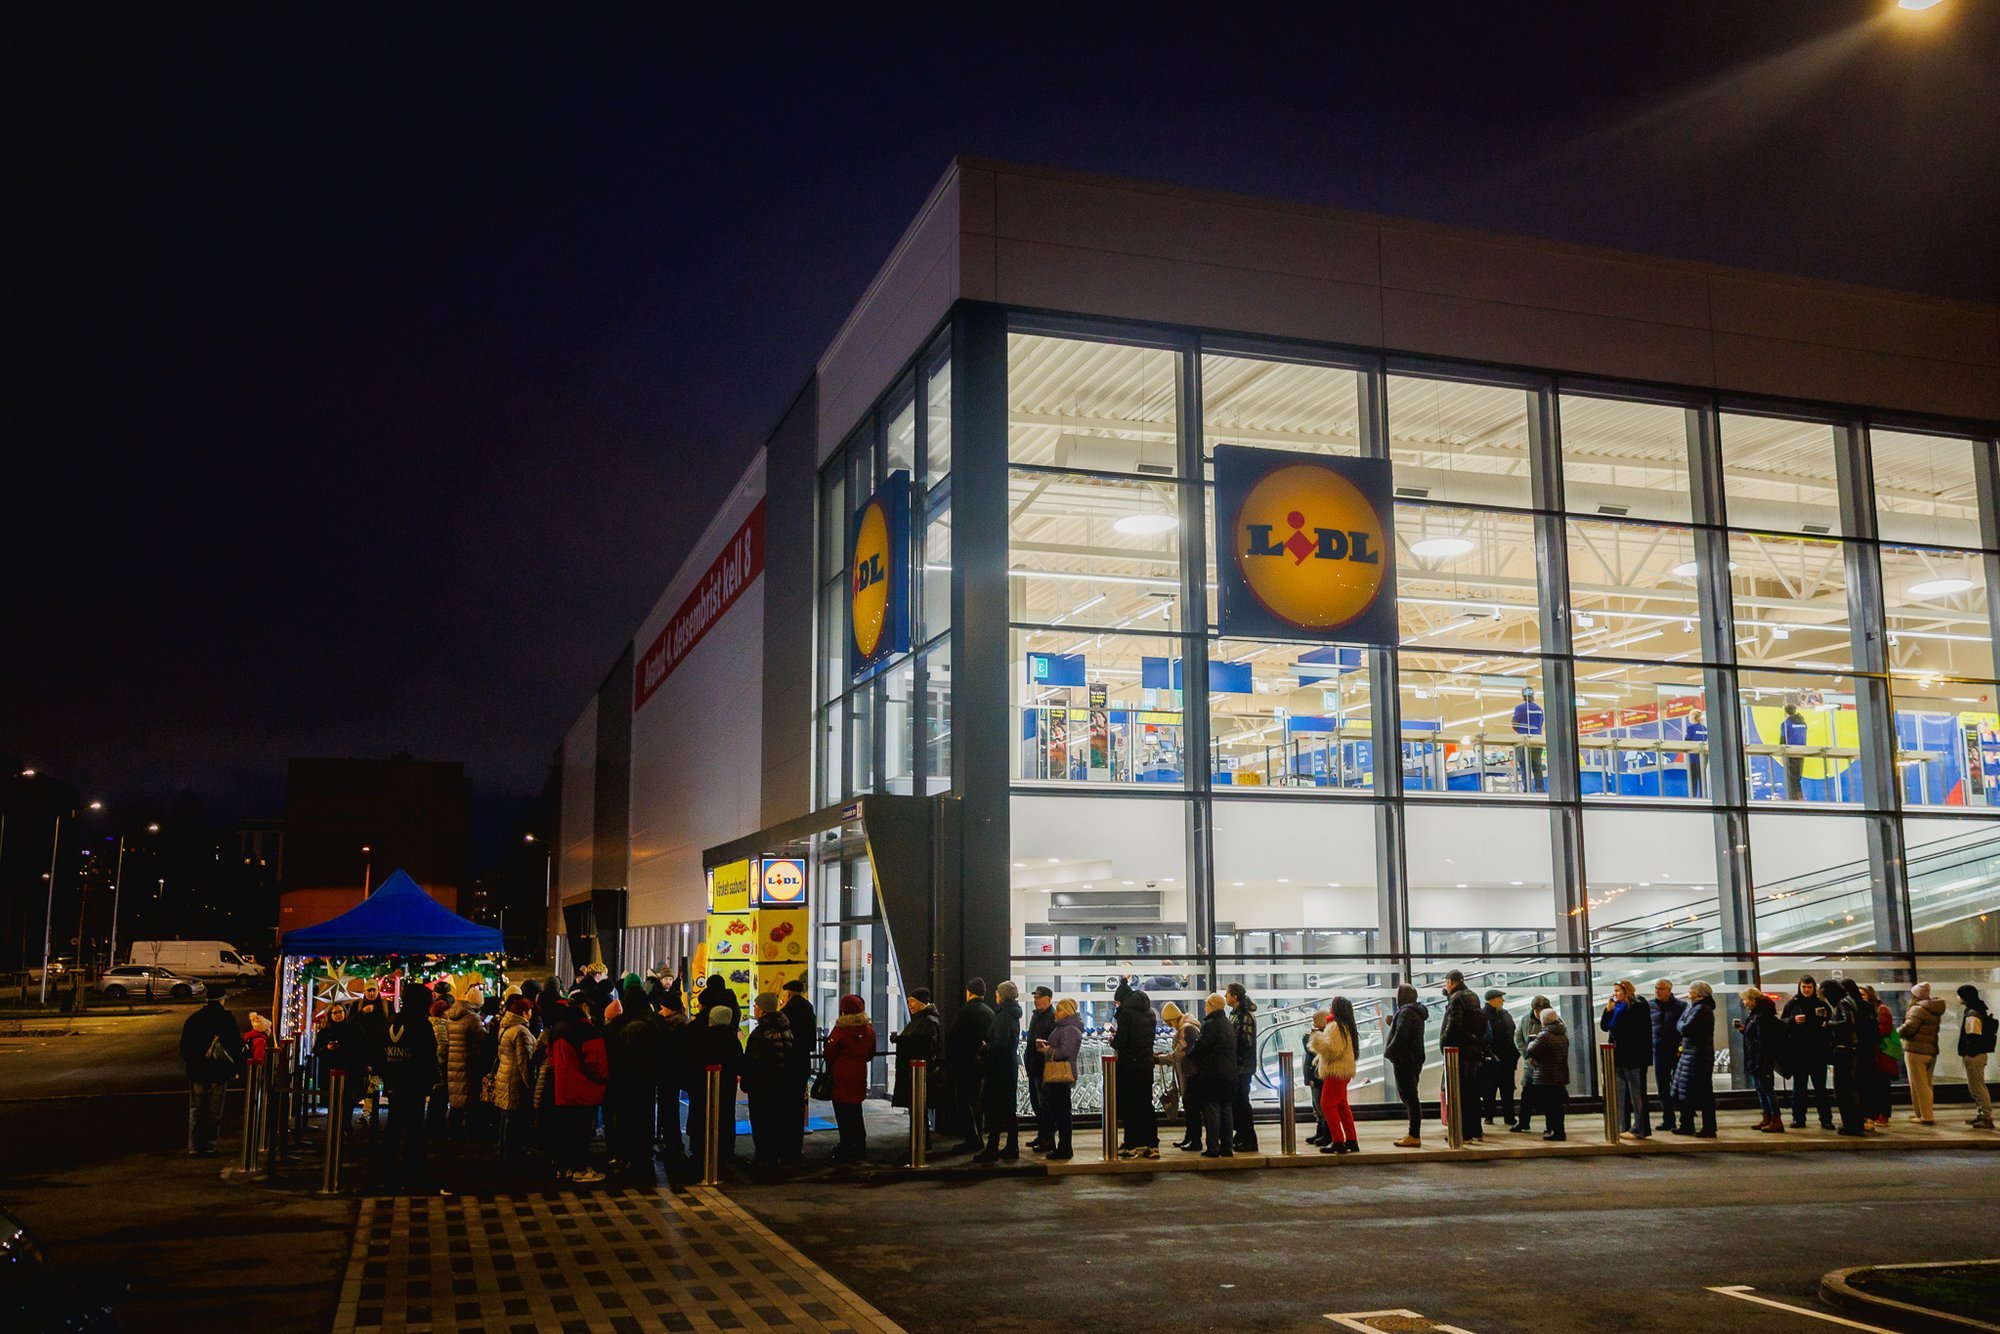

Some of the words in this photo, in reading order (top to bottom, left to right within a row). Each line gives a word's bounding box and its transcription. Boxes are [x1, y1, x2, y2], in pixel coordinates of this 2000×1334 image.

[722, 538, 742, 602] kell
[744, 527, 752, 577] 8
[1246, 510, 1379, 566] LIDL
[768, 873, 800, 886] LIDL
